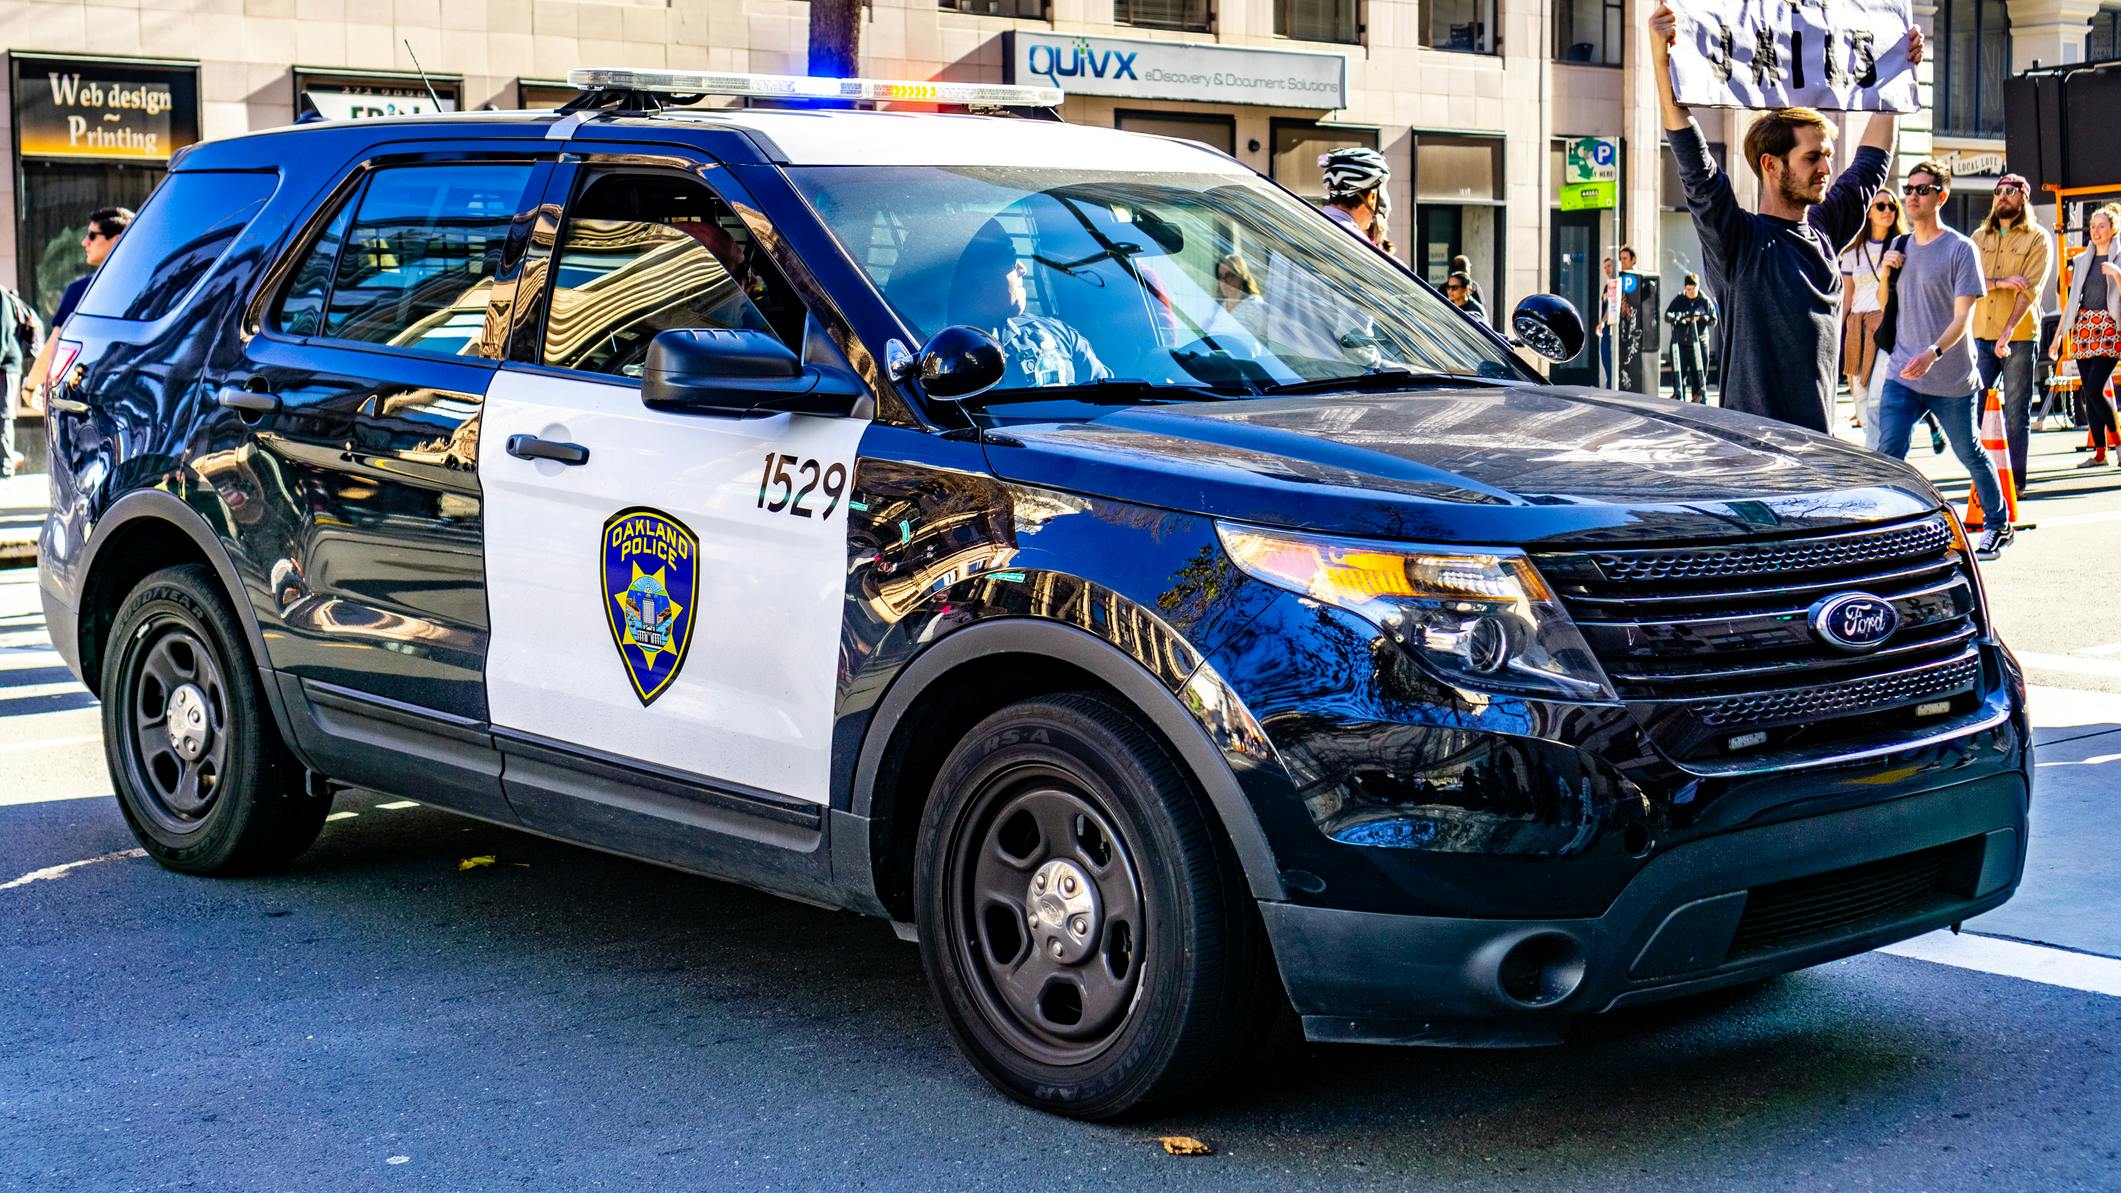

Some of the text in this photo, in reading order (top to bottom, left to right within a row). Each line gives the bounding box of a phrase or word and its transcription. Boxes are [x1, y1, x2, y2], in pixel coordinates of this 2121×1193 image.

[49, 72, 172, 115] Web design
[1146, 69, 1338, 93] eDiscovery & Document Solutions
[67, 115, 158, 154] Printing
[1598, 146, 1611, 163] P
[1958, 156, 1998, 172] LOCAL LOVE
[1624, 277, 1632, 290] P
[757, 452, 847, 521] 1529
[612, 518, 689, 560] OAKLAND
[621, 537, 678, 571] POLICE
[1844, 604, 1886, 636] Ford
